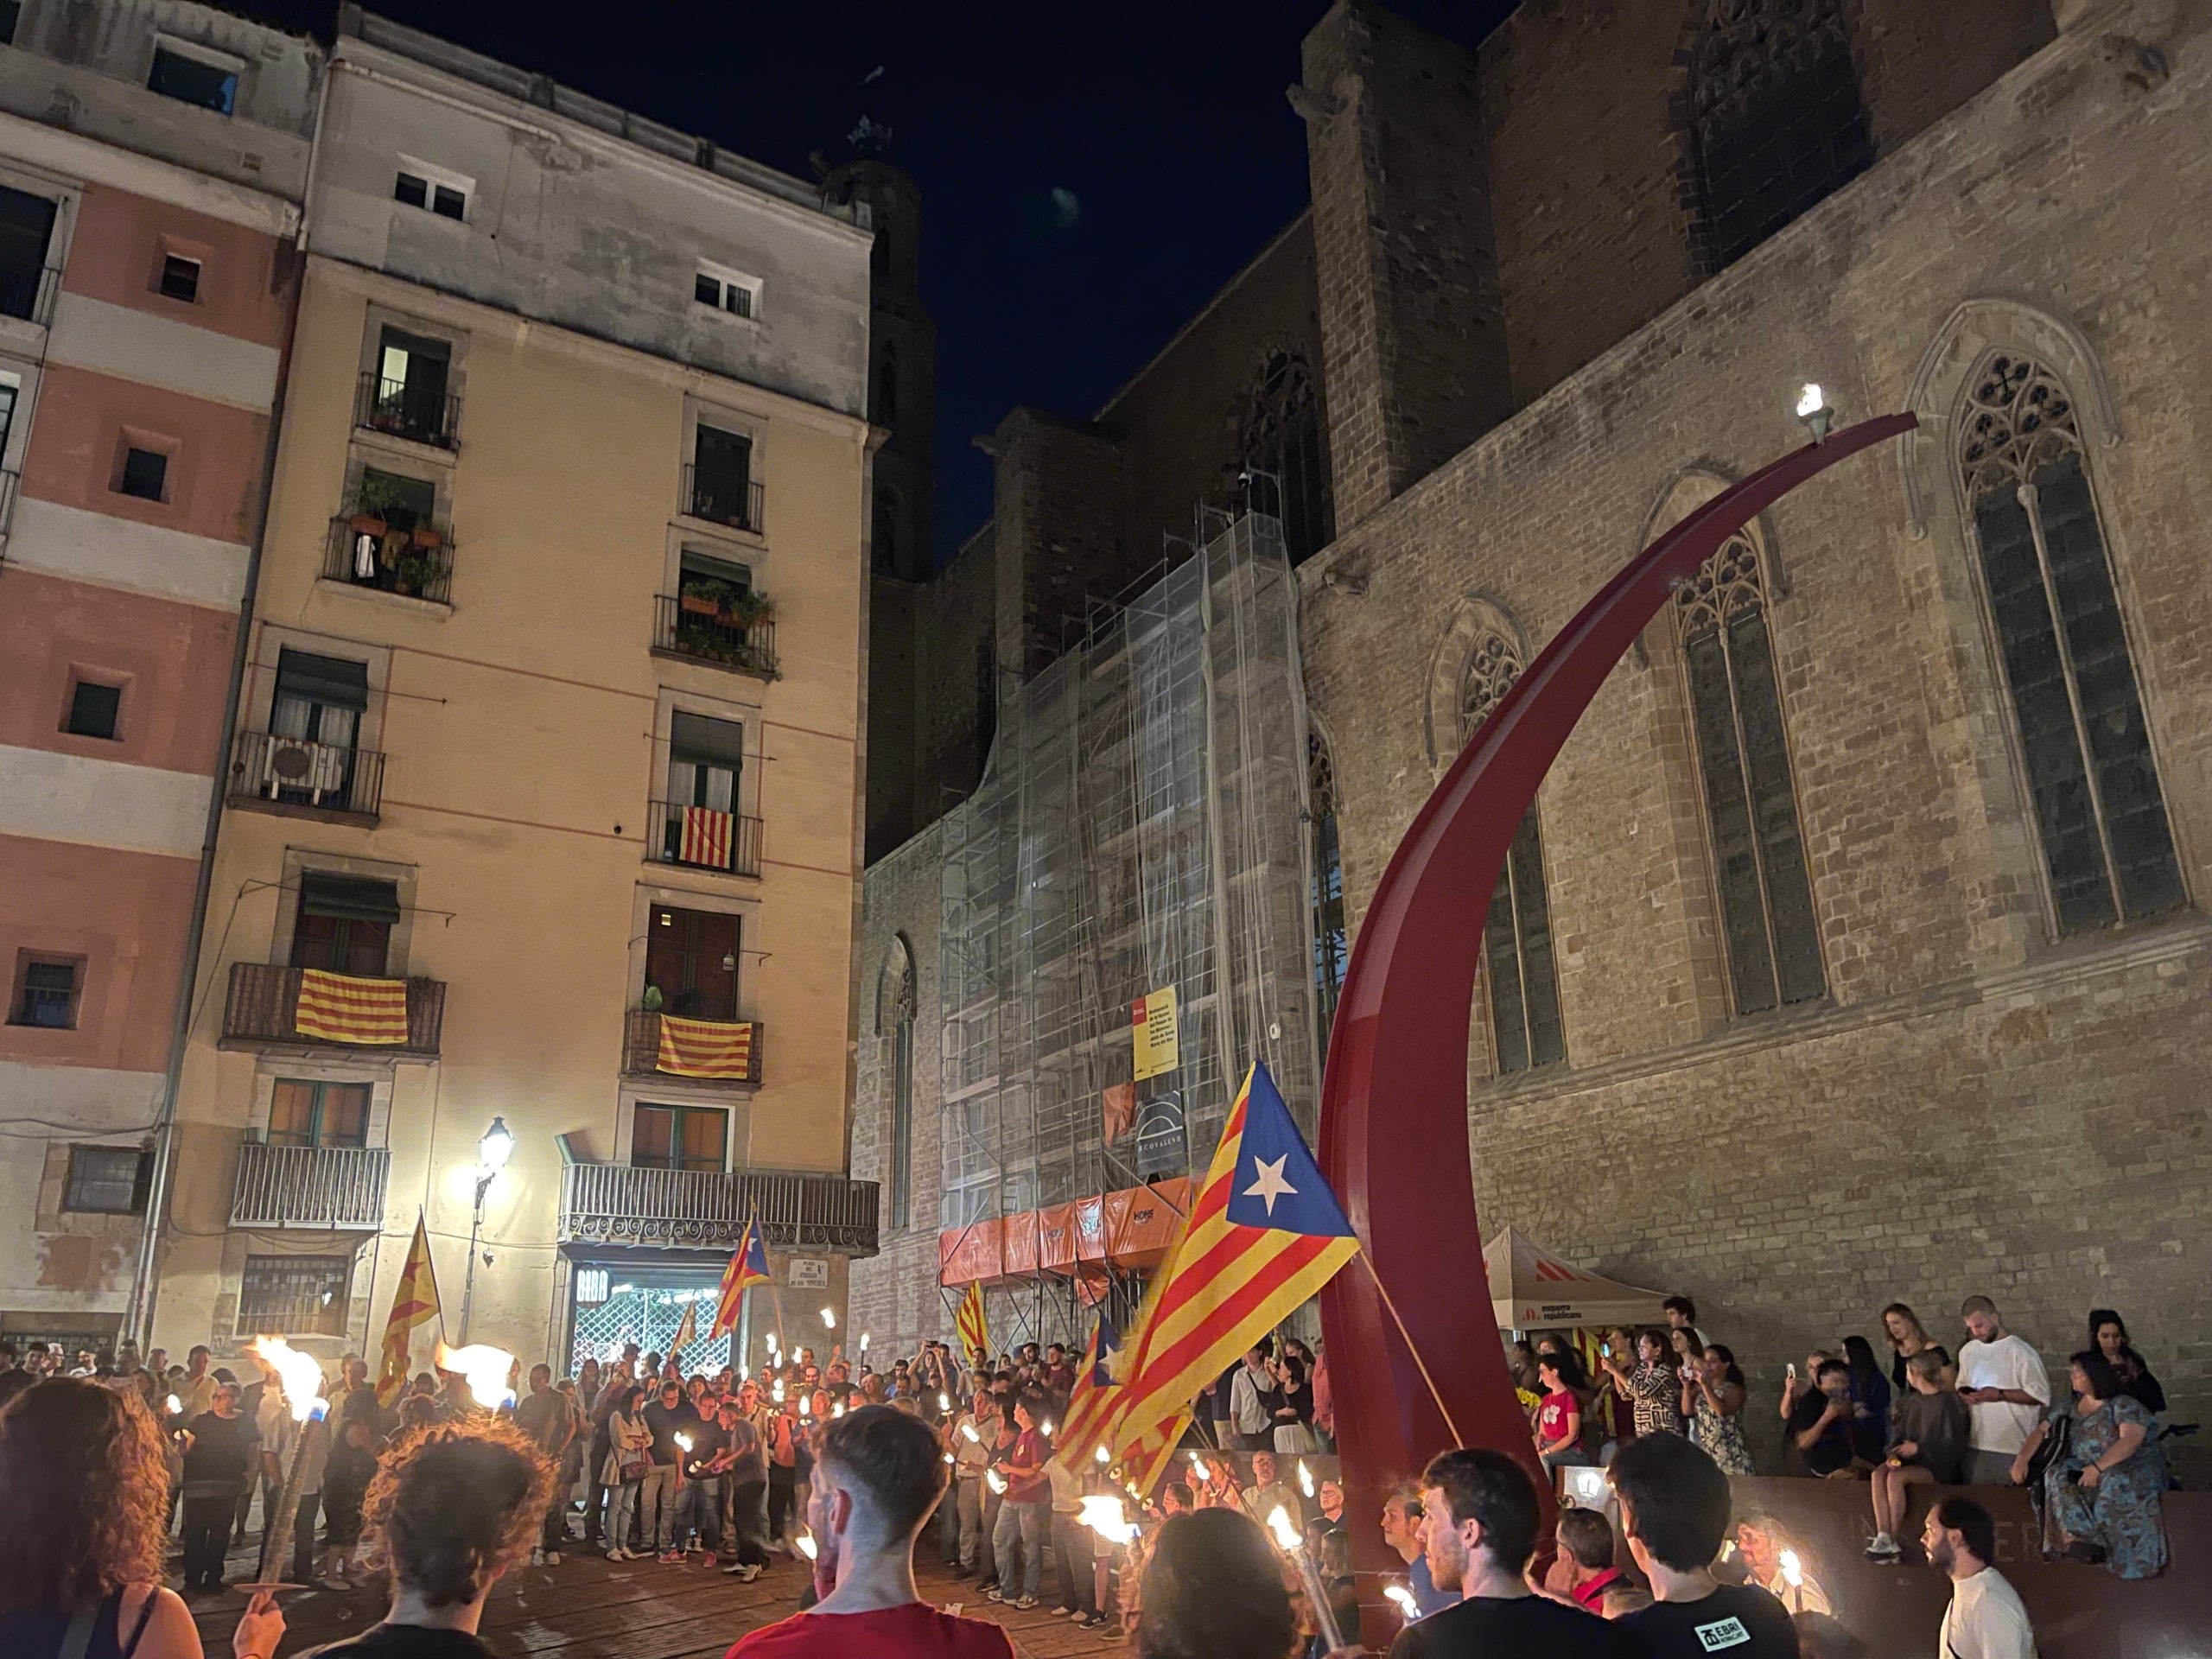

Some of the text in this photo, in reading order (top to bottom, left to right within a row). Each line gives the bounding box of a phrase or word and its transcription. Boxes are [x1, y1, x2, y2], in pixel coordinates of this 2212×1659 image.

[576, 1269, 608, 1302] BIBA
[1543, 1312, 1582, 1321] republicana
[1715, 1621, 1740, 1637] EBRI
